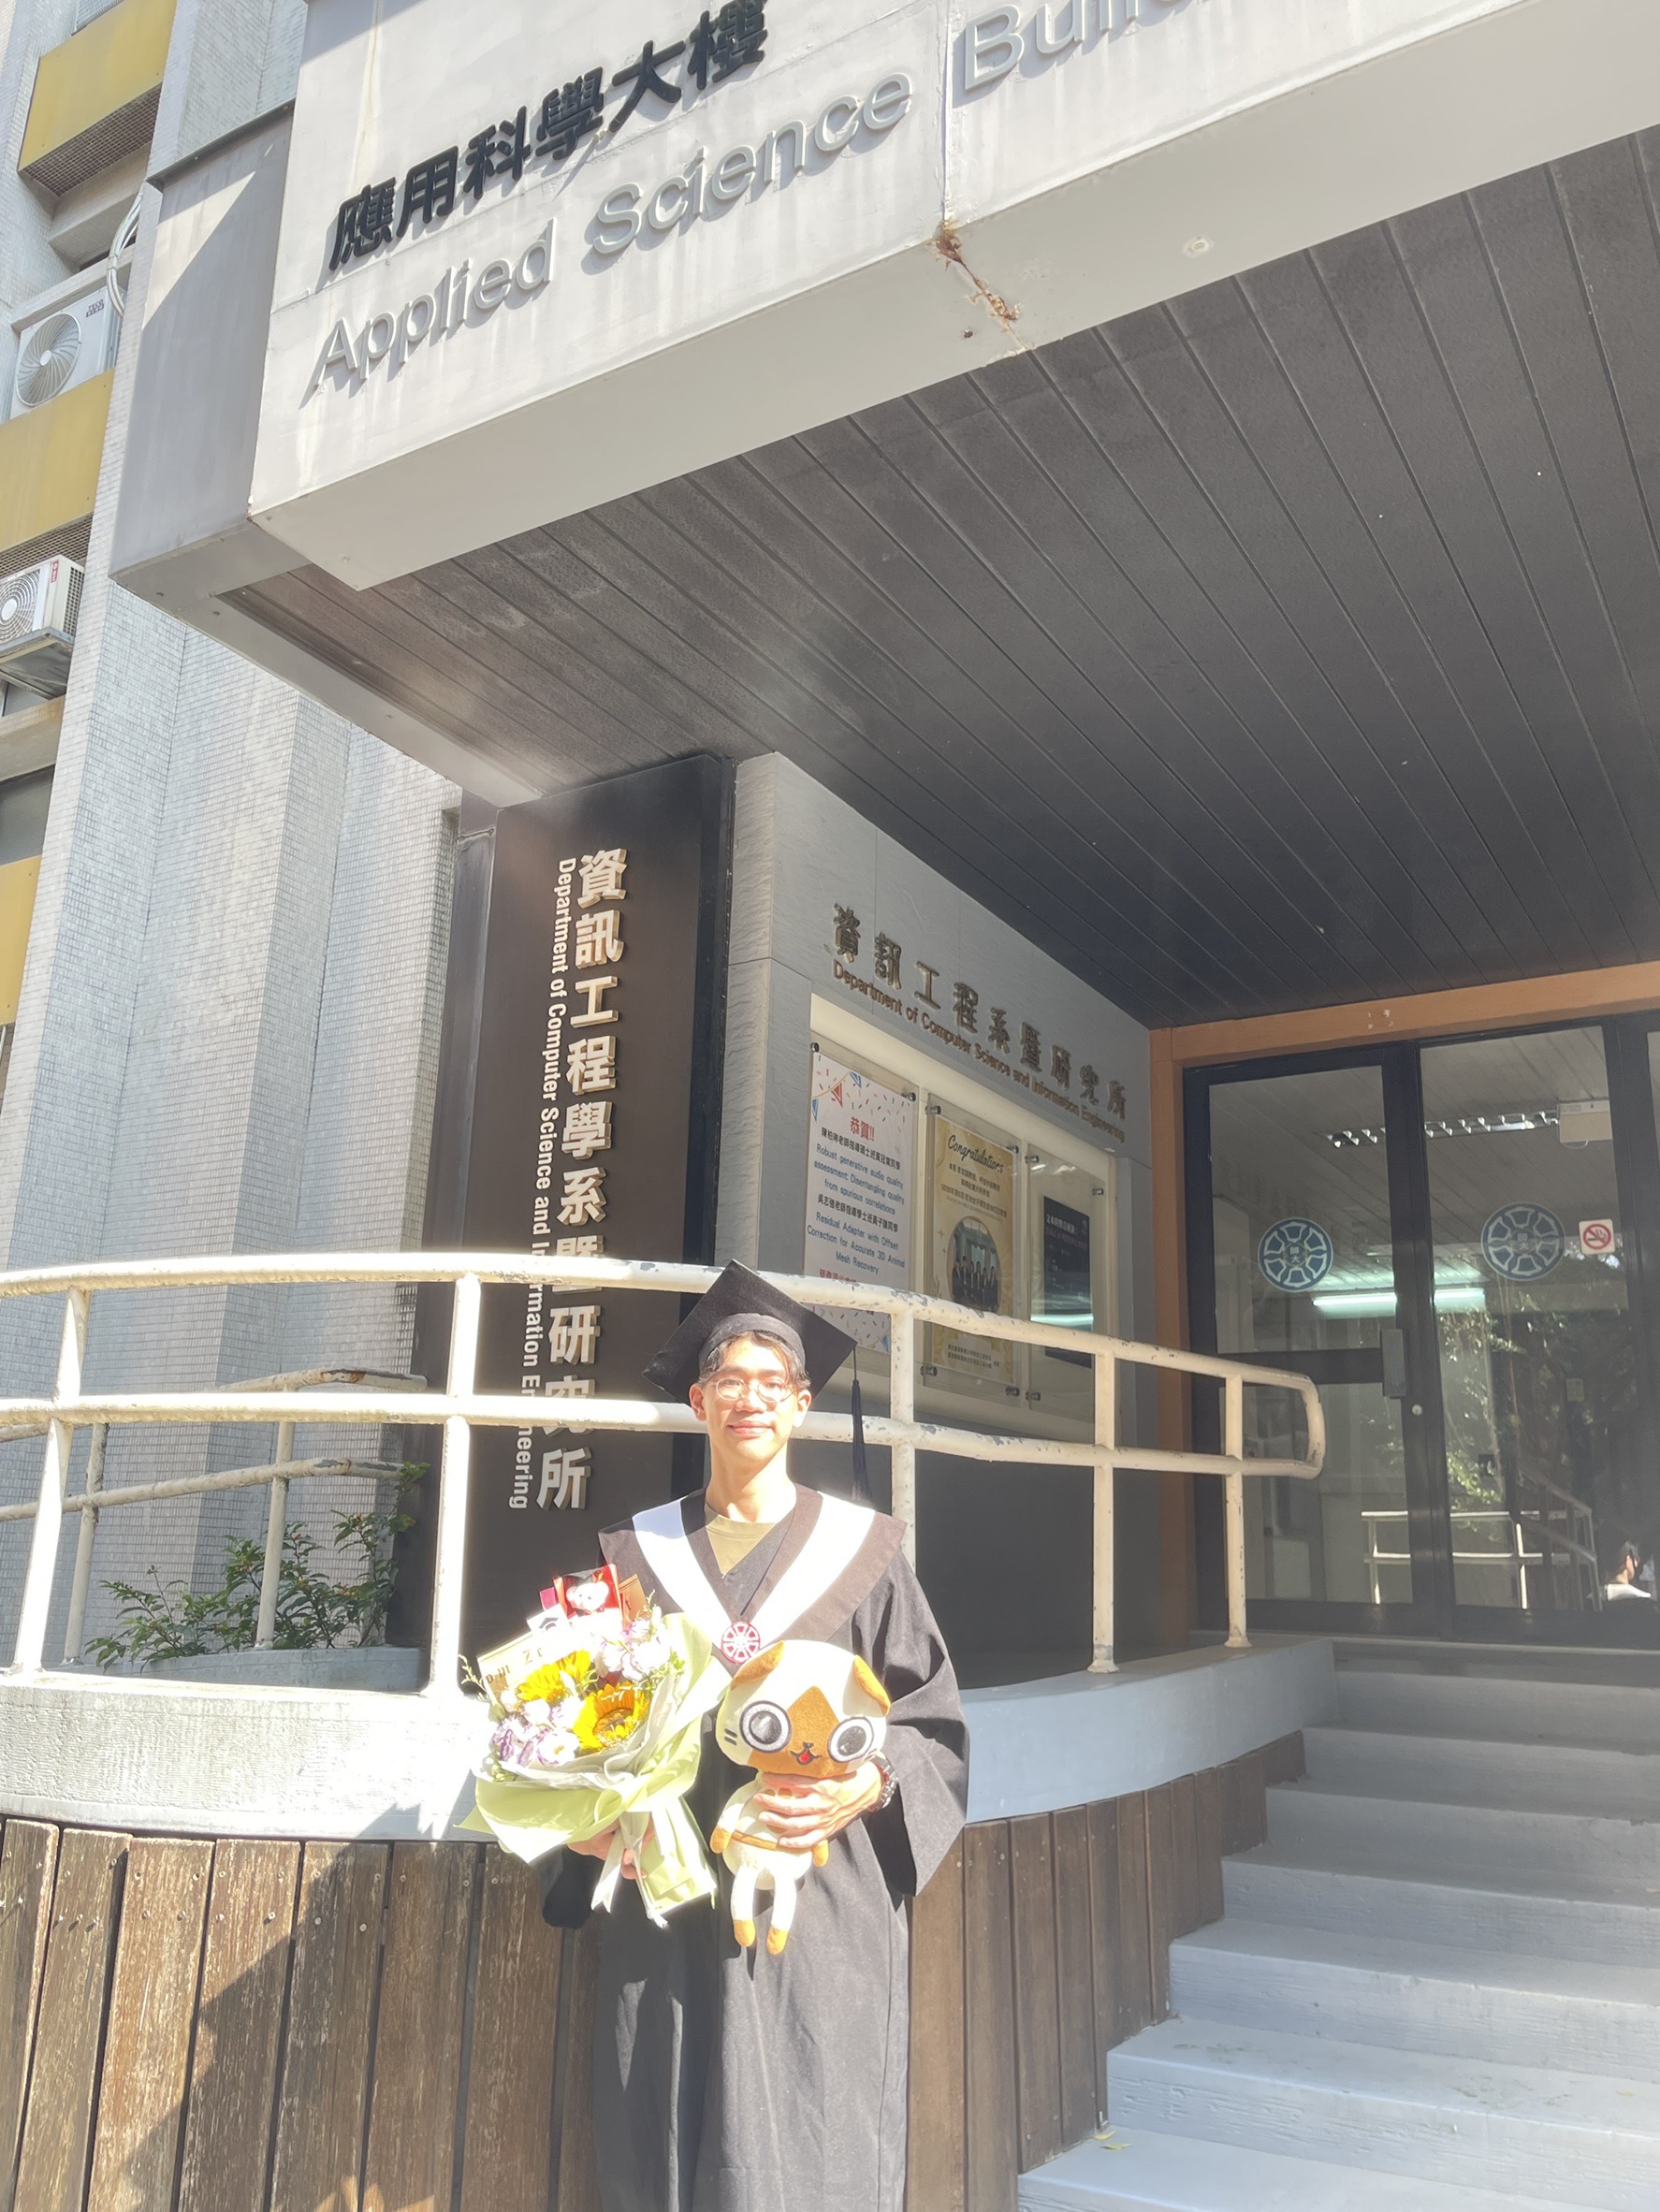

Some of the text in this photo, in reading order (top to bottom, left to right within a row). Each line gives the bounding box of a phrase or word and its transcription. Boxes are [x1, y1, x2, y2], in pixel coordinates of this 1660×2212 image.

[329, 0, 768, 270] 應用科學大樓
[316, 217, 557, 387] Applied
[593, 72, 913, 255] Science
[833, 959, 903, 1016] Department
[905, 1006, 919, 1024] of
[921, 1011, 971, 1055] Computer
[974, 1042, 1011, 1077] Science
[1012, 1070, 1029, 1088] and
[508, 857, 576, 1508] Department of Computer Science and Irmation Enneering
[816, 1142, 904, 1190] Robust generative audio quality
[824, 1179, 896, 1215] from spurious correlations
[850, 1173, 886, 1198] Disentangling
[887, 1191, 905, 1206] quality
[807, 1224, 906, 1268] Correction for Accurate 3D Animal
[816, 1212, 840, 1230] Residual
[867, 1233, 880, 1244] with
[881, 1236, 899, 1252] Offset
[836, 1250, 851, 1265] Mesh
[852, 1257, 879, 1275] Recovery
